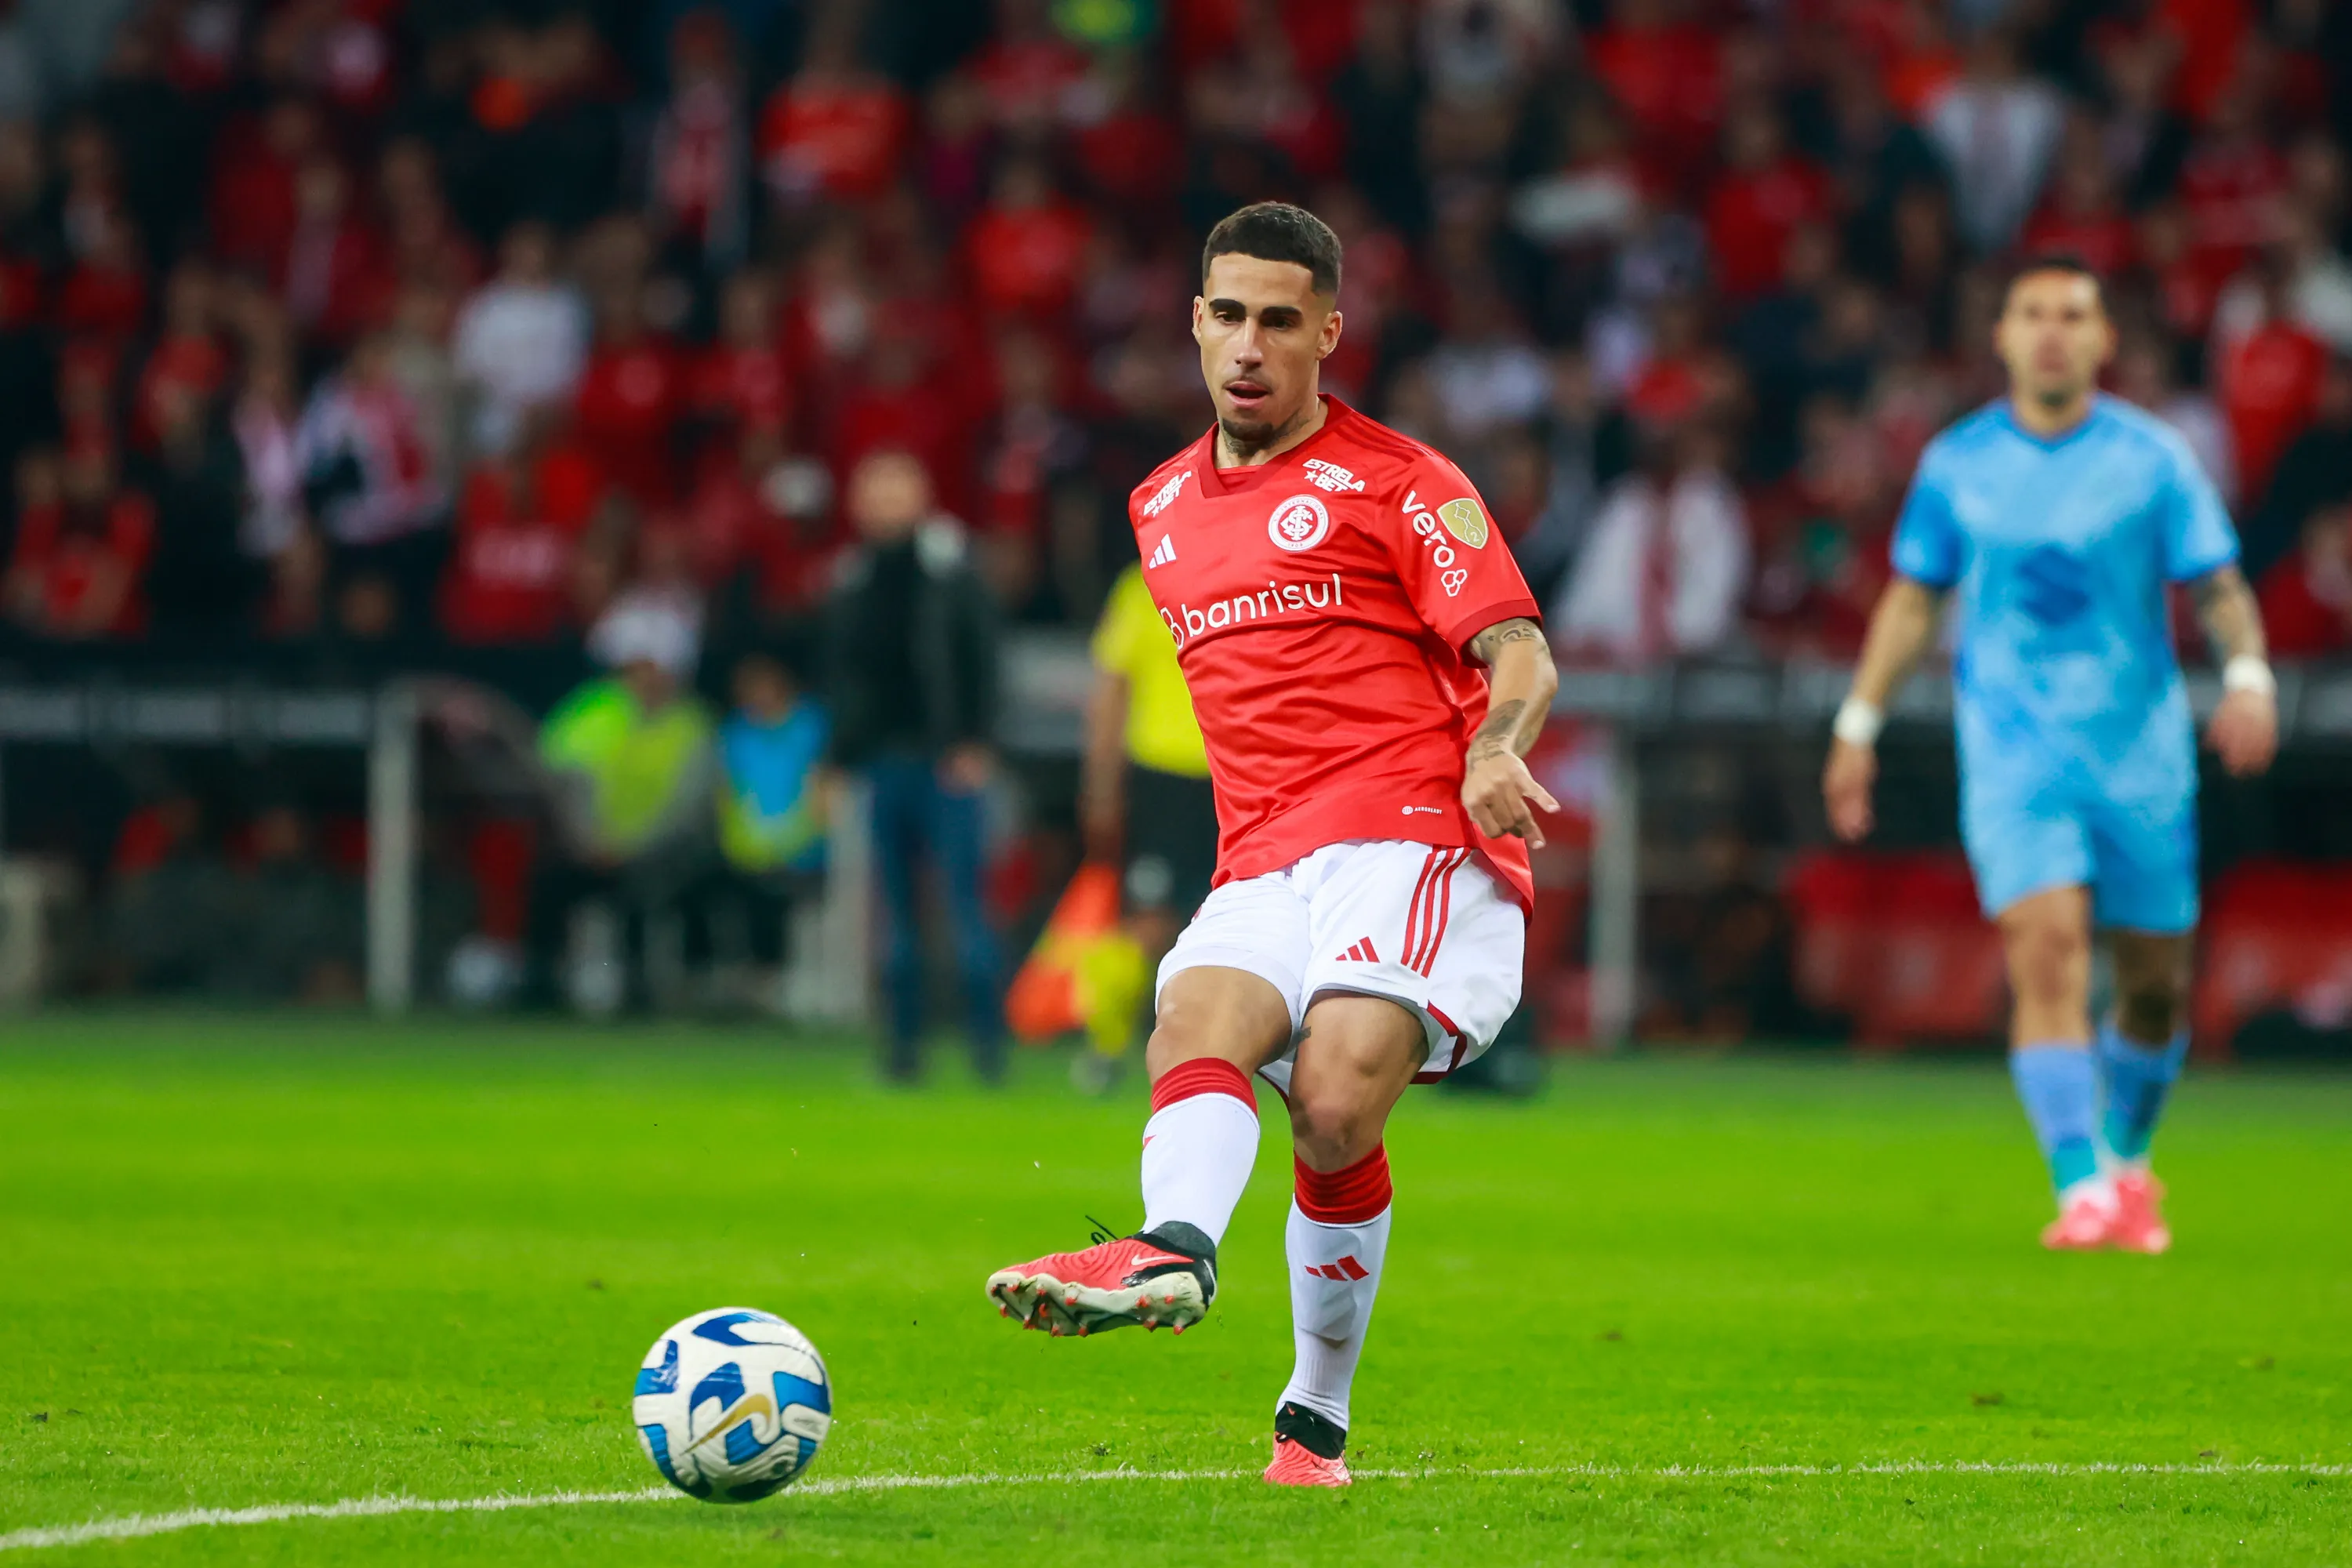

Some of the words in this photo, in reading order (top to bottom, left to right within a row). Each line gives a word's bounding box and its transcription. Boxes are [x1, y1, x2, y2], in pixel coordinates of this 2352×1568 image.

[1302, 458, 1366, 492] ESTRELA
[1314, 473, 1348, 492] BET
[1160, 483, 1182, 511] BET
[1470, 532, 1480, 543] 2
[1181, 573, 1342, 637] banrisul
